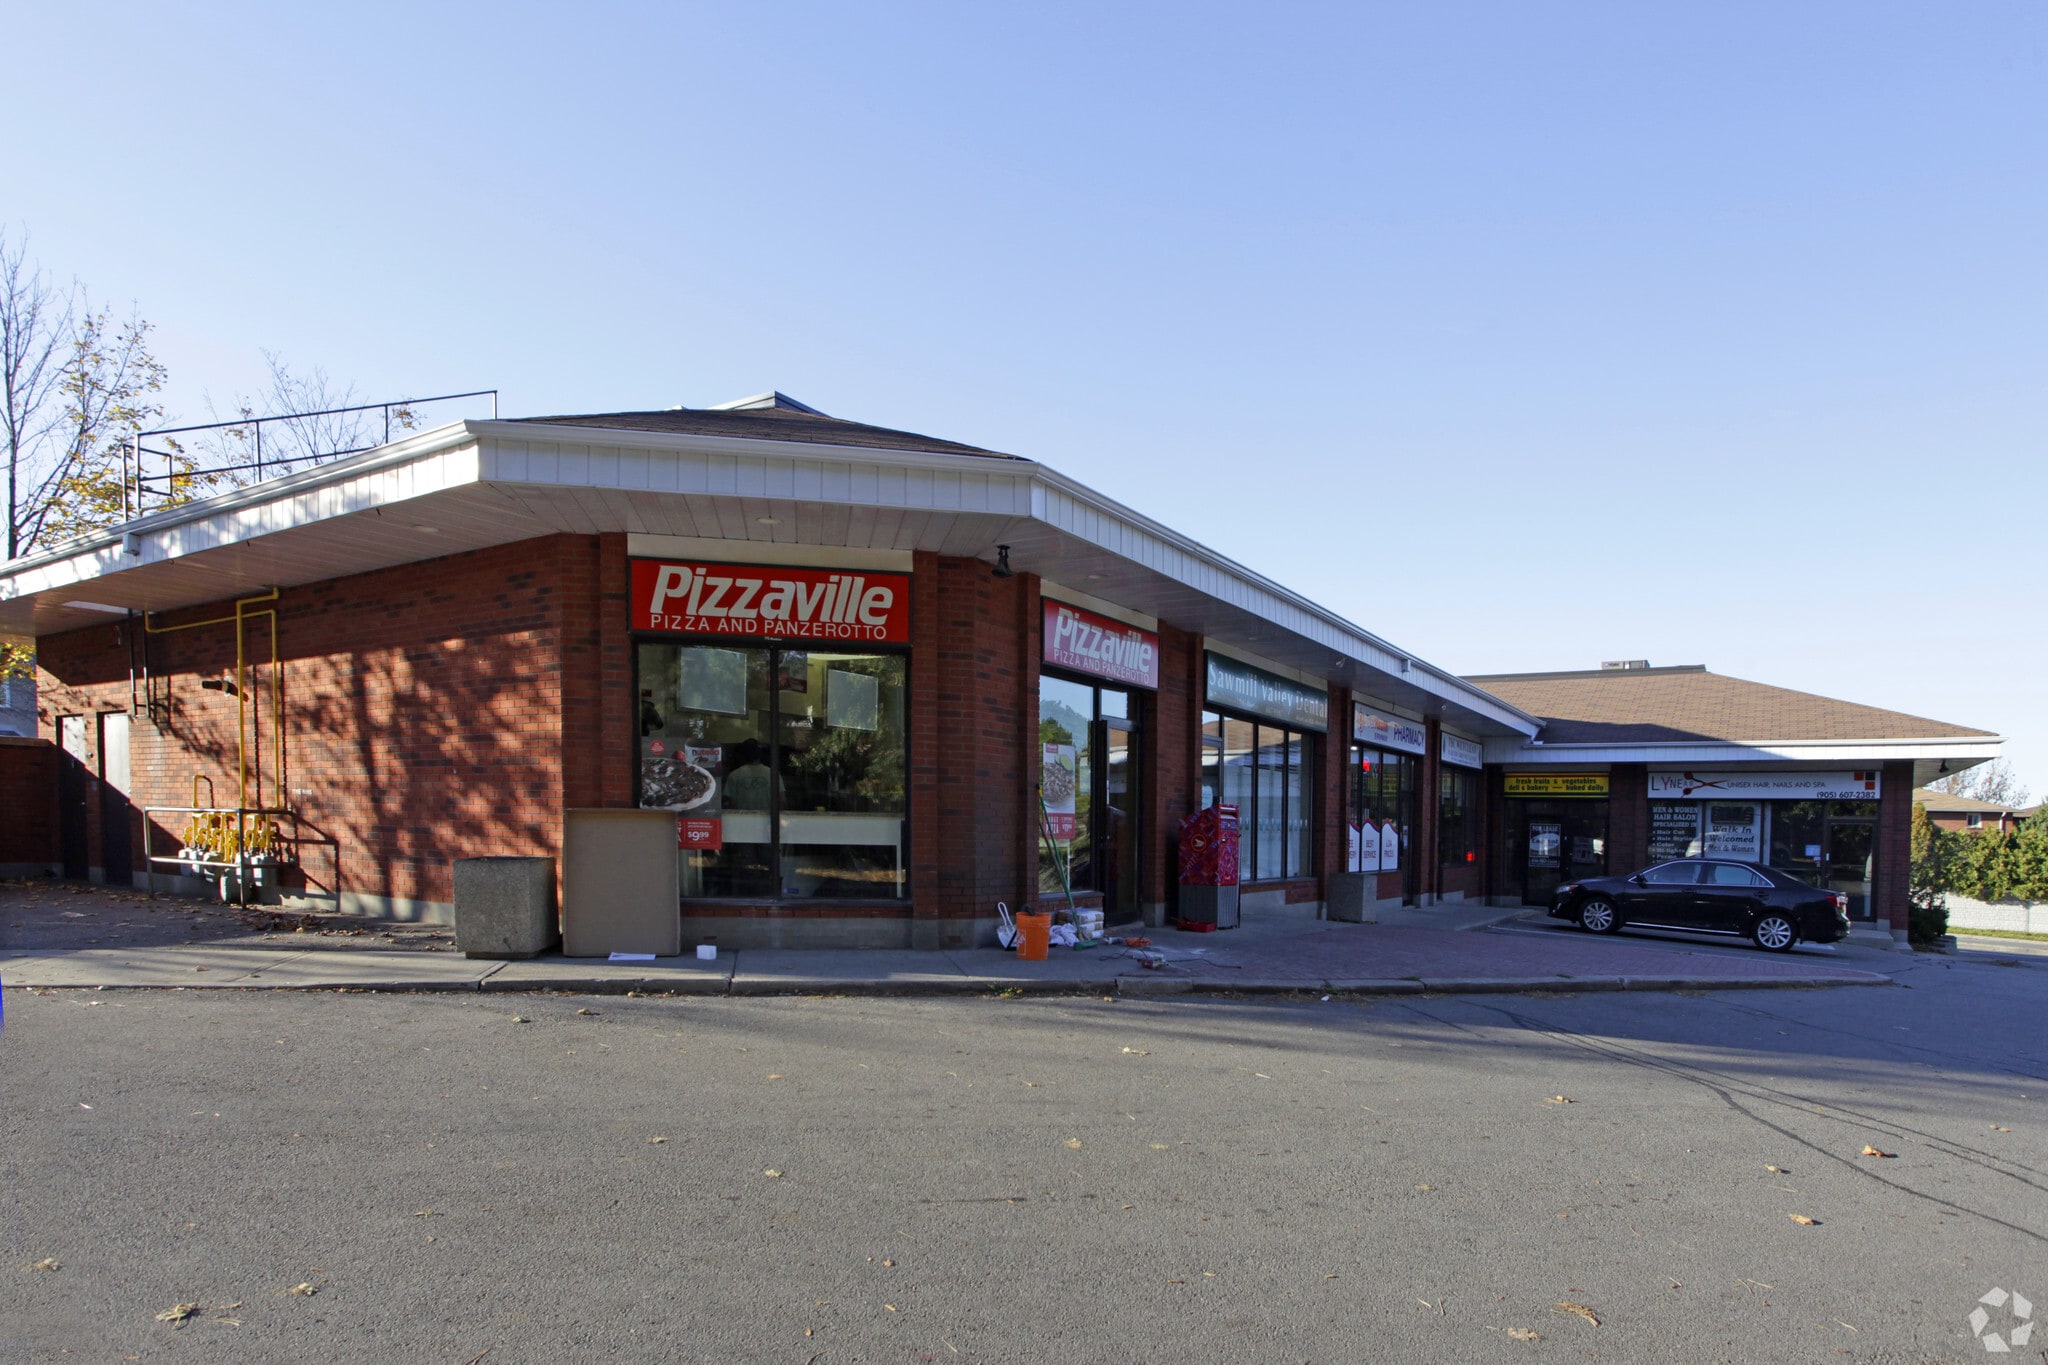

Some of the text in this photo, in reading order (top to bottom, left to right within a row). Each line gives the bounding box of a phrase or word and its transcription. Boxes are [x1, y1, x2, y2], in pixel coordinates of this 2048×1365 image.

[650, 565, 894, 625] Pizzaville
[651, 614, 887, 640] PIZZA AND PANZEROTTO
[1054, 607, 1152, 673] Pizzaville
[1054, 649, 1150, 684] PIZZA AND PANZEROTTO
[1209, 662, 1257, 698] Sawmill
[1261, 678, 1294, 707] Valley
[1296, 690, 1328, 718] Dental
[1393, 725, 1424, 747] PHARMACY
[1712, 826, 1752, 834] Walk In
